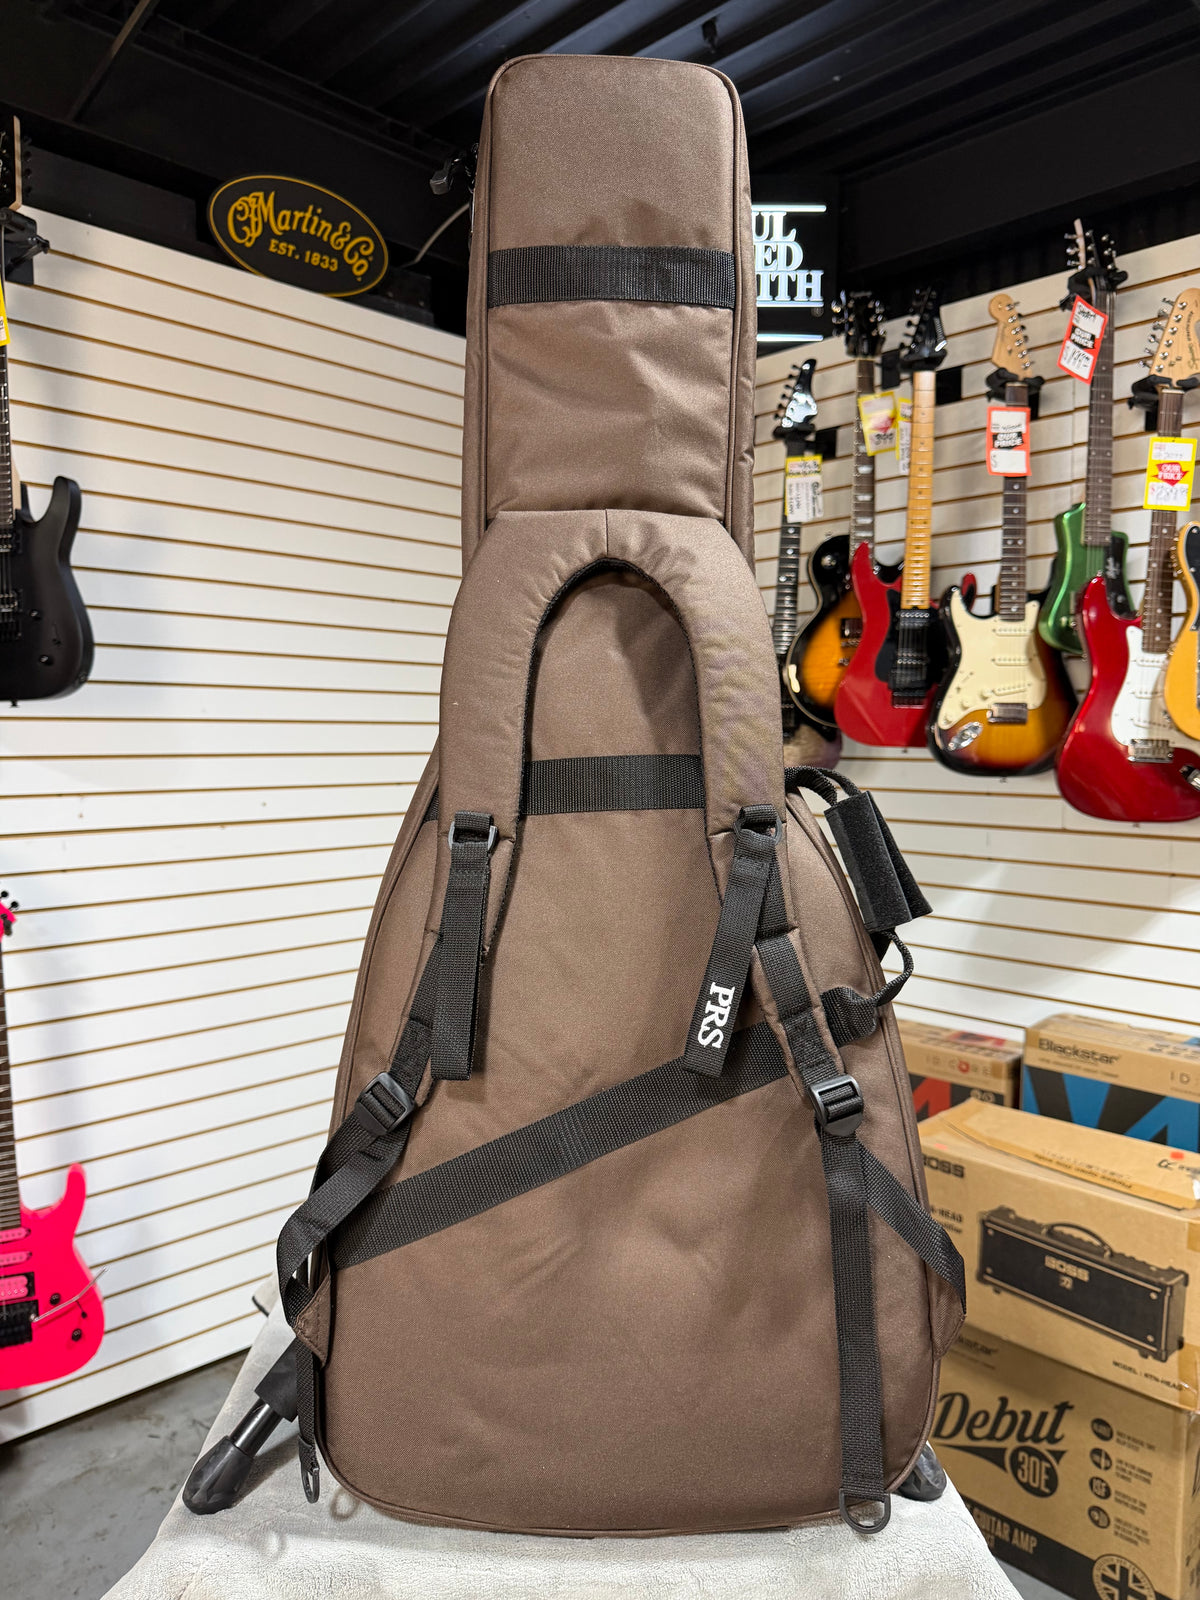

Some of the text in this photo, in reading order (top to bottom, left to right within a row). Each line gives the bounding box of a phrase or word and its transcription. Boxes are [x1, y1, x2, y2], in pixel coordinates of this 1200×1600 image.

[304, 250, 339, 272] 1833
[757, 270, 825, 301] ITH
[697, 982, 736, 1049] PRS
[1038, 1037, 1120, 1065] Blackstar
[1044, 1255, 1089, 1282] BOSS
[932, 1391, 1075, 1445] Debut
[1016, 1451, 1053, 1494] 30E
[1011, 1527, 1038, 1555] AMP
